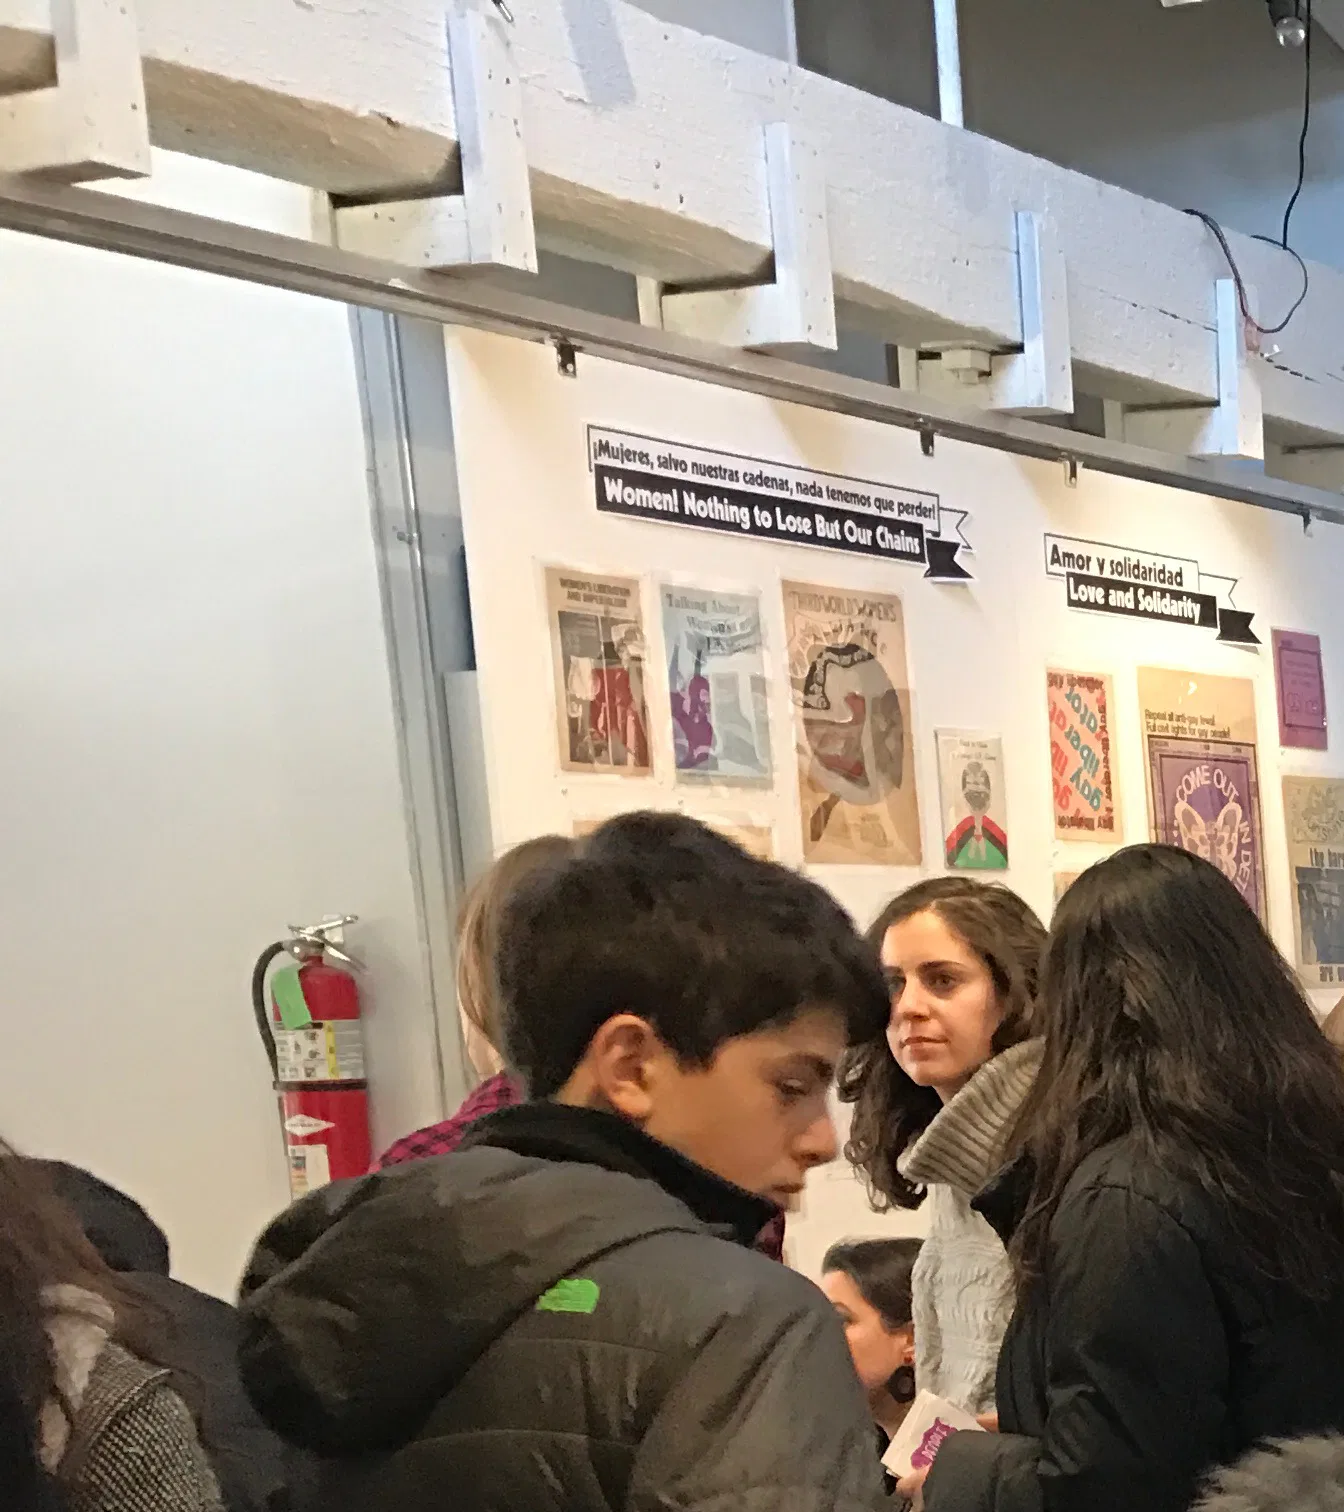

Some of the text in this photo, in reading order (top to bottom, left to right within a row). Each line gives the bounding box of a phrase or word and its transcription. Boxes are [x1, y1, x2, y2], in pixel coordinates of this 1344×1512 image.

[593, 439, 936, 520] ¡Mujeres, salvo nuestras cadenas, nada tenemos que perder!
[604, 476, 920, 554] Women! Nothing to Lose But Our Chains
[1050, 543, 1183, 587] Amor y solidaridad
[1069, 577, 1200, 624] Love and Solidarity
[1176, 765, 1210, 803] COME
[1214, 768, 1240, 804] OUT
